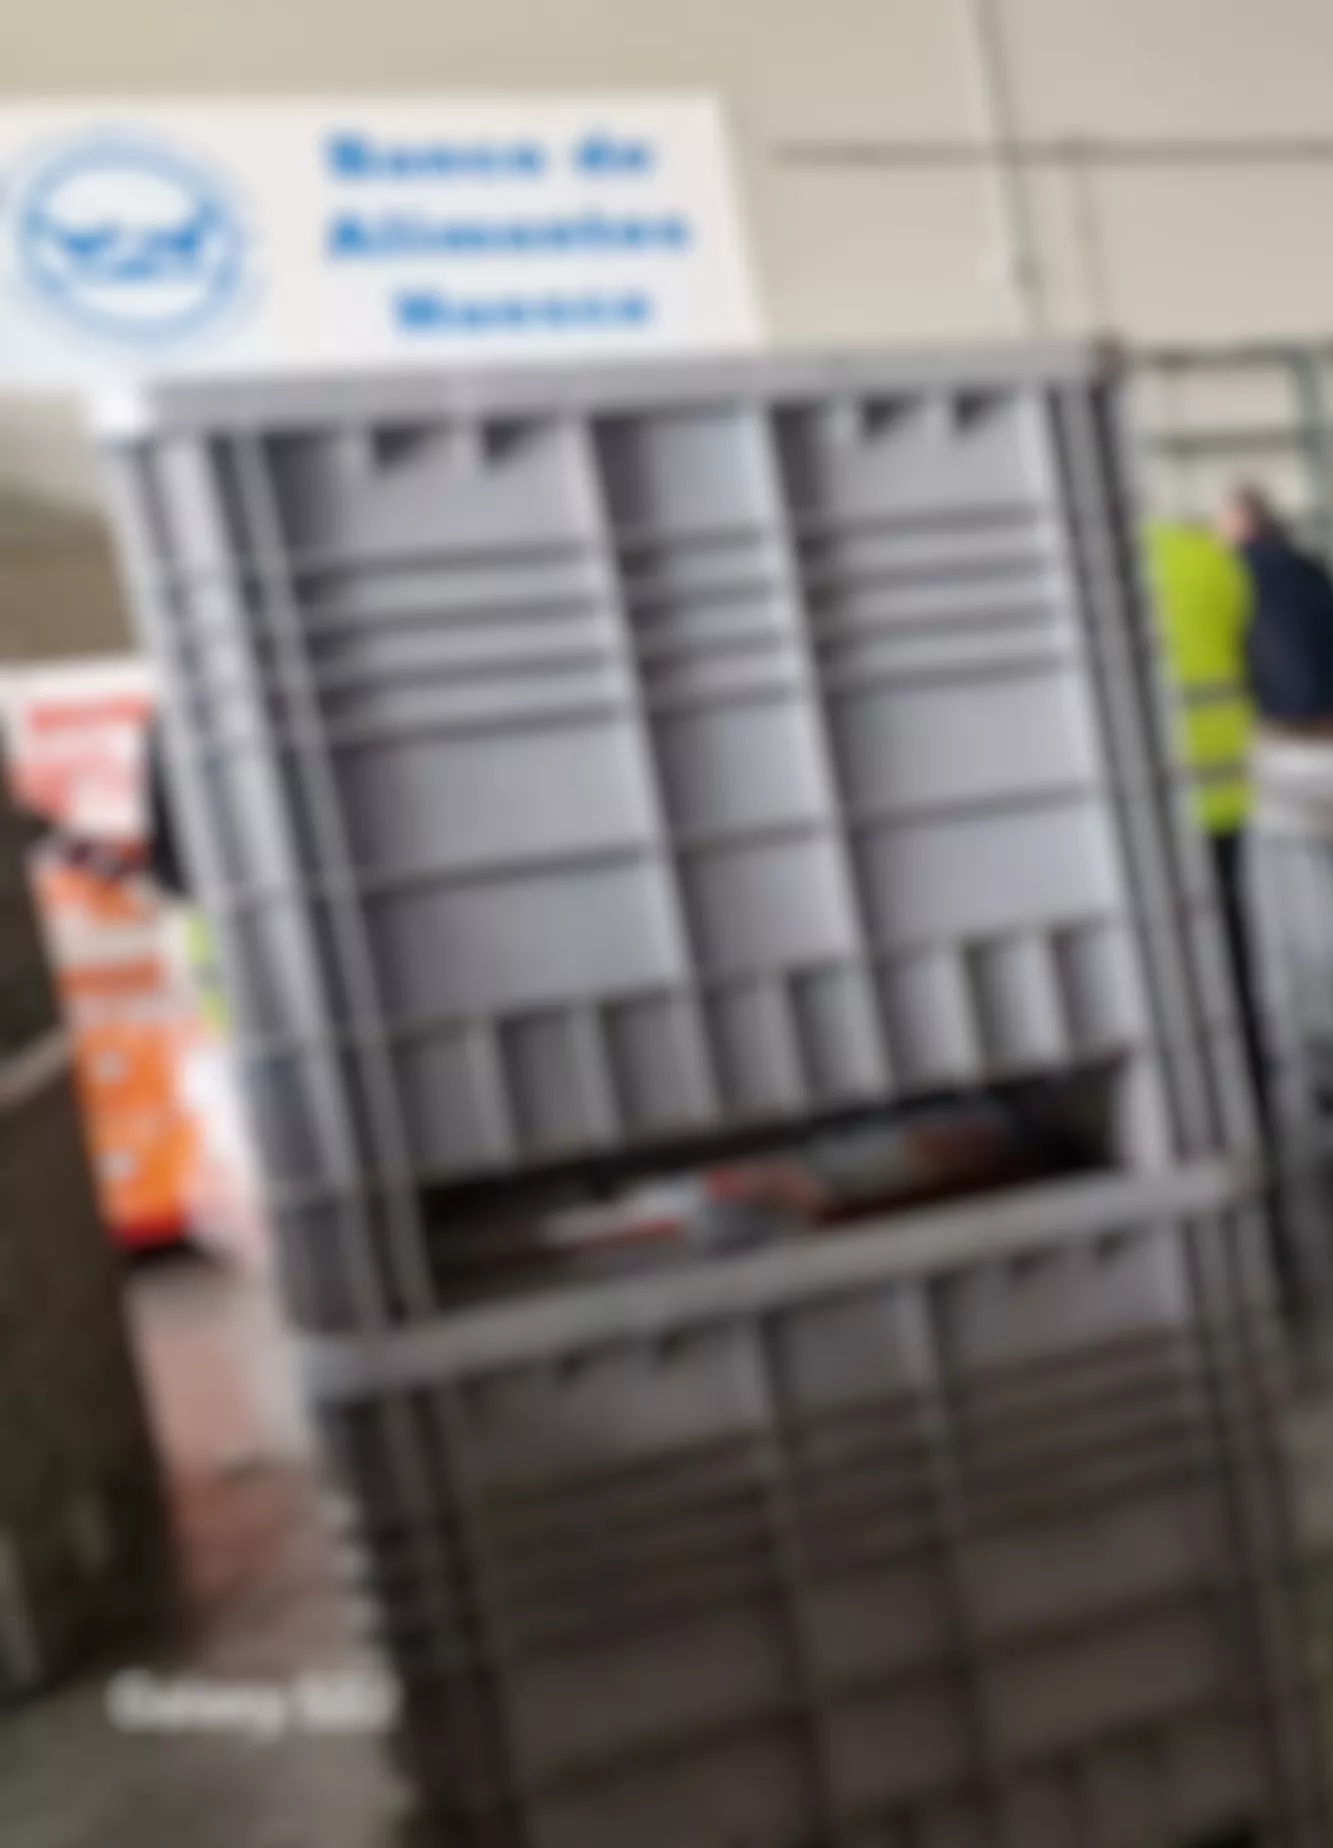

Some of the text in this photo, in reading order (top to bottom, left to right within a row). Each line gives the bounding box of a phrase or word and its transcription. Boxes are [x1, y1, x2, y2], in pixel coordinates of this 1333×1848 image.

[327, 130, 648, 180] Banco de
[329, 209, 688, 259] Alimentos
[393, 288, 649, 334] Huesca
